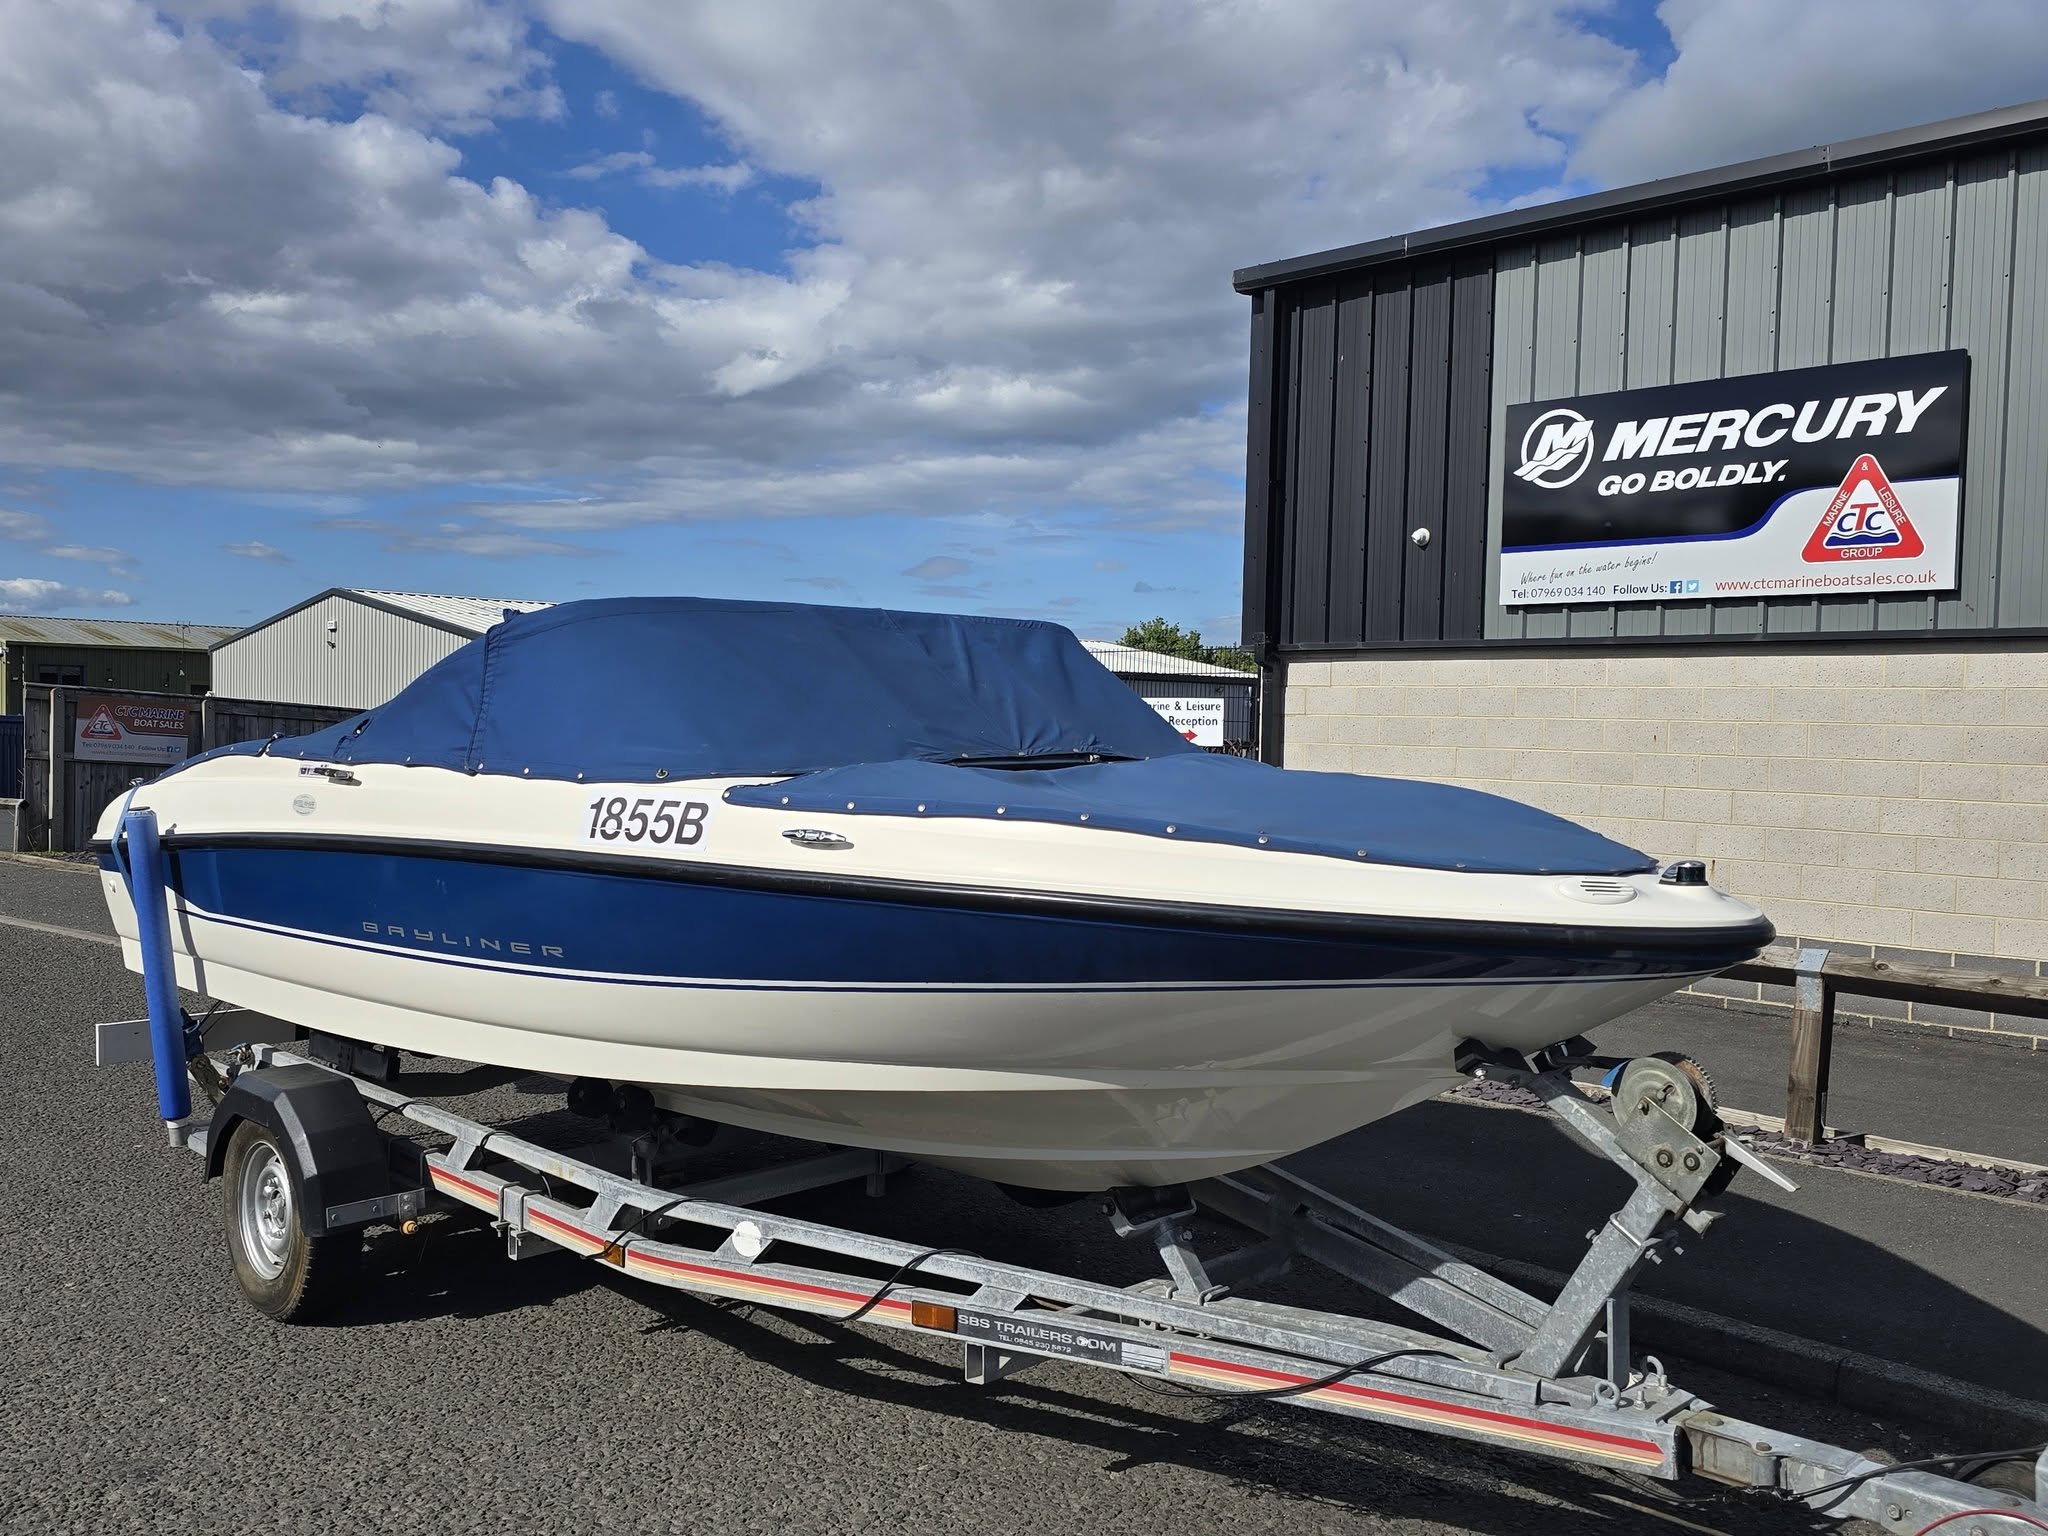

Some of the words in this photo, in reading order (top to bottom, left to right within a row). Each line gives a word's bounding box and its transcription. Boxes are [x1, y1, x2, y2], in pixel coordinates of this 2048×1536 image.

[1602, 385, 1948, 462] MERCURY
[1861, 462, 1869, 471] &
[1597, 471, 1646, 496] GO
[1649, 459, 1789, 492] BOLDLY.
[1823, 489, 1851, 527] MARINE
[1878, 486, 1907, 526] LEISURE
[1836, 502, 1885, 532] CTC
[1840, 547, 1883, 558] GROUP
[1520, 572, 1546, 586] Where
[1549, 568, 1563, 583] fun
[1566, 569, 1575, 578] on
[1578, 563, 1592, 575] the
[1595, 560, 1621, 572] water
[1624, 551, 1658, 572] begins!
[1715, 569, 1937, 591] www.ctcmarineboatsales.co.uk
[1511, 588, 1529, 599] Tel:
[1530, 587, 1563, 599] 07969
[1564, 586, 1584, 597] 034
[1587, 585, 1606, 597] 140
[1613, 583, 1649, 595] Follow
[1651, 582, 1668, 593] Us:
[114, 705, 138, 717] CTC
[139, 707, 185, 721] MARINE
[1147, 701, 1170, 711] rine
[1174, 700, 1182, 711] &
[1186, 700, 1221, 711] Leisure
[93, 720, 110, 731] CTC
[133, 718, 158, 728] BOAT
[159, 720, 184, 730] SALES
[1168, 715, 1218, 728] Reception
[589, 796, 710, 845] 1855B
[362, 921, 565, 958] BAYLINER
[958, 1314, 991, 1329] SBS
